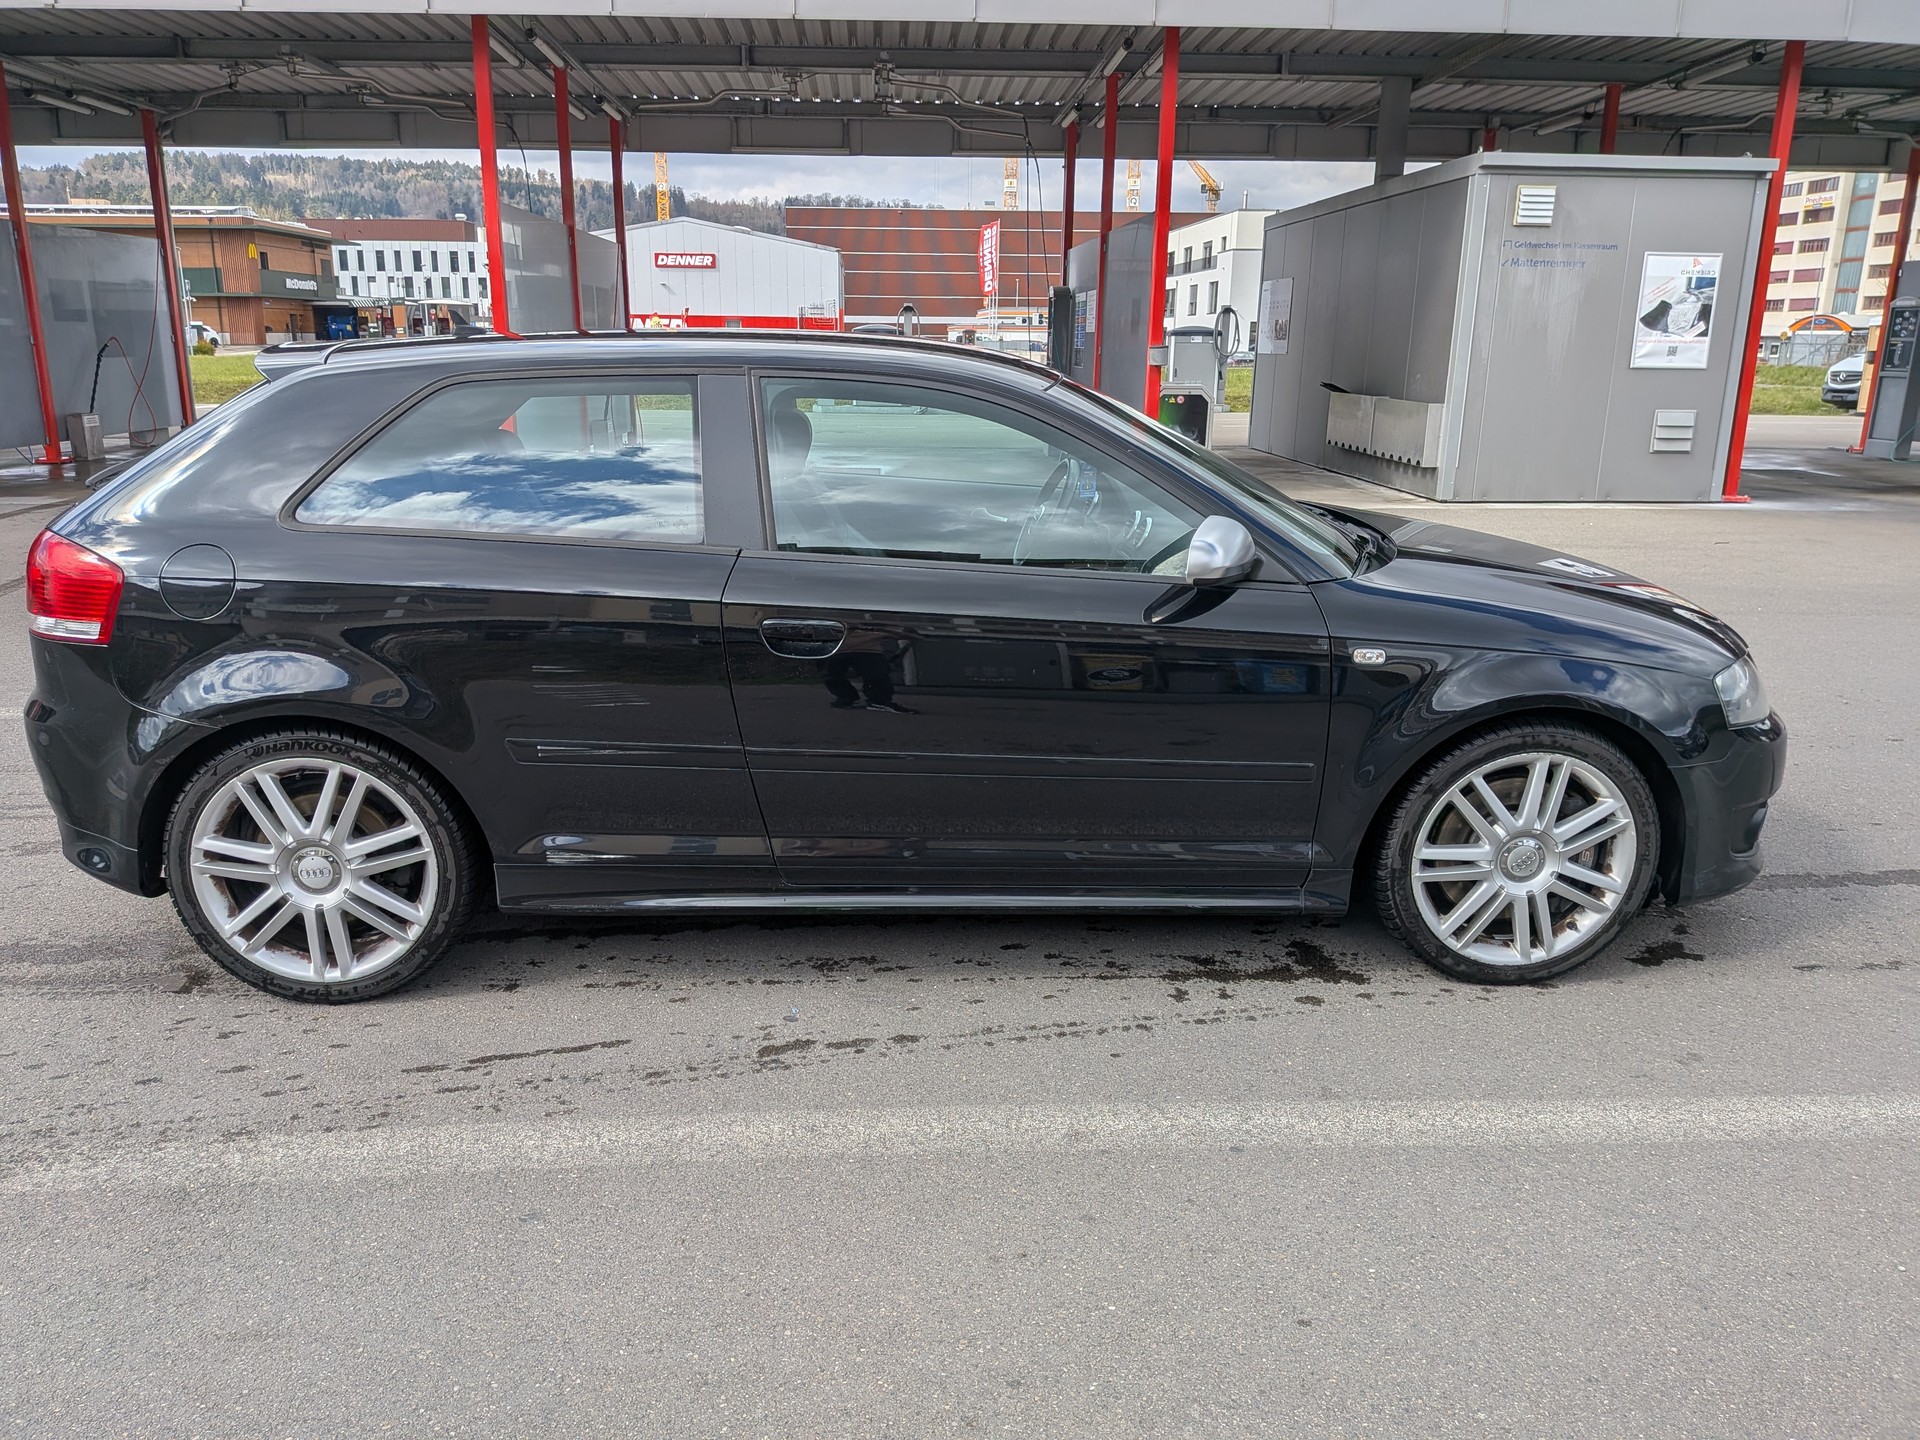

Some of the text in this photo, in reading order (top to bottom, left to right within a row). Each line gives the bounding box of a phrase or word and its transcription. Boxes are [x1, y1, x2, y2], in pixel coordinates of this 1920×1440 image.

[1805, 196, 1833, 204] Pneuhaus
[1514, 240, 1560, 250] Geldwechsel
[657, 255, 713, 266] DENNER
[1510, 258, 1586, 271] Mattenreiniger
[285, 278, 318, 291] McDonald's
